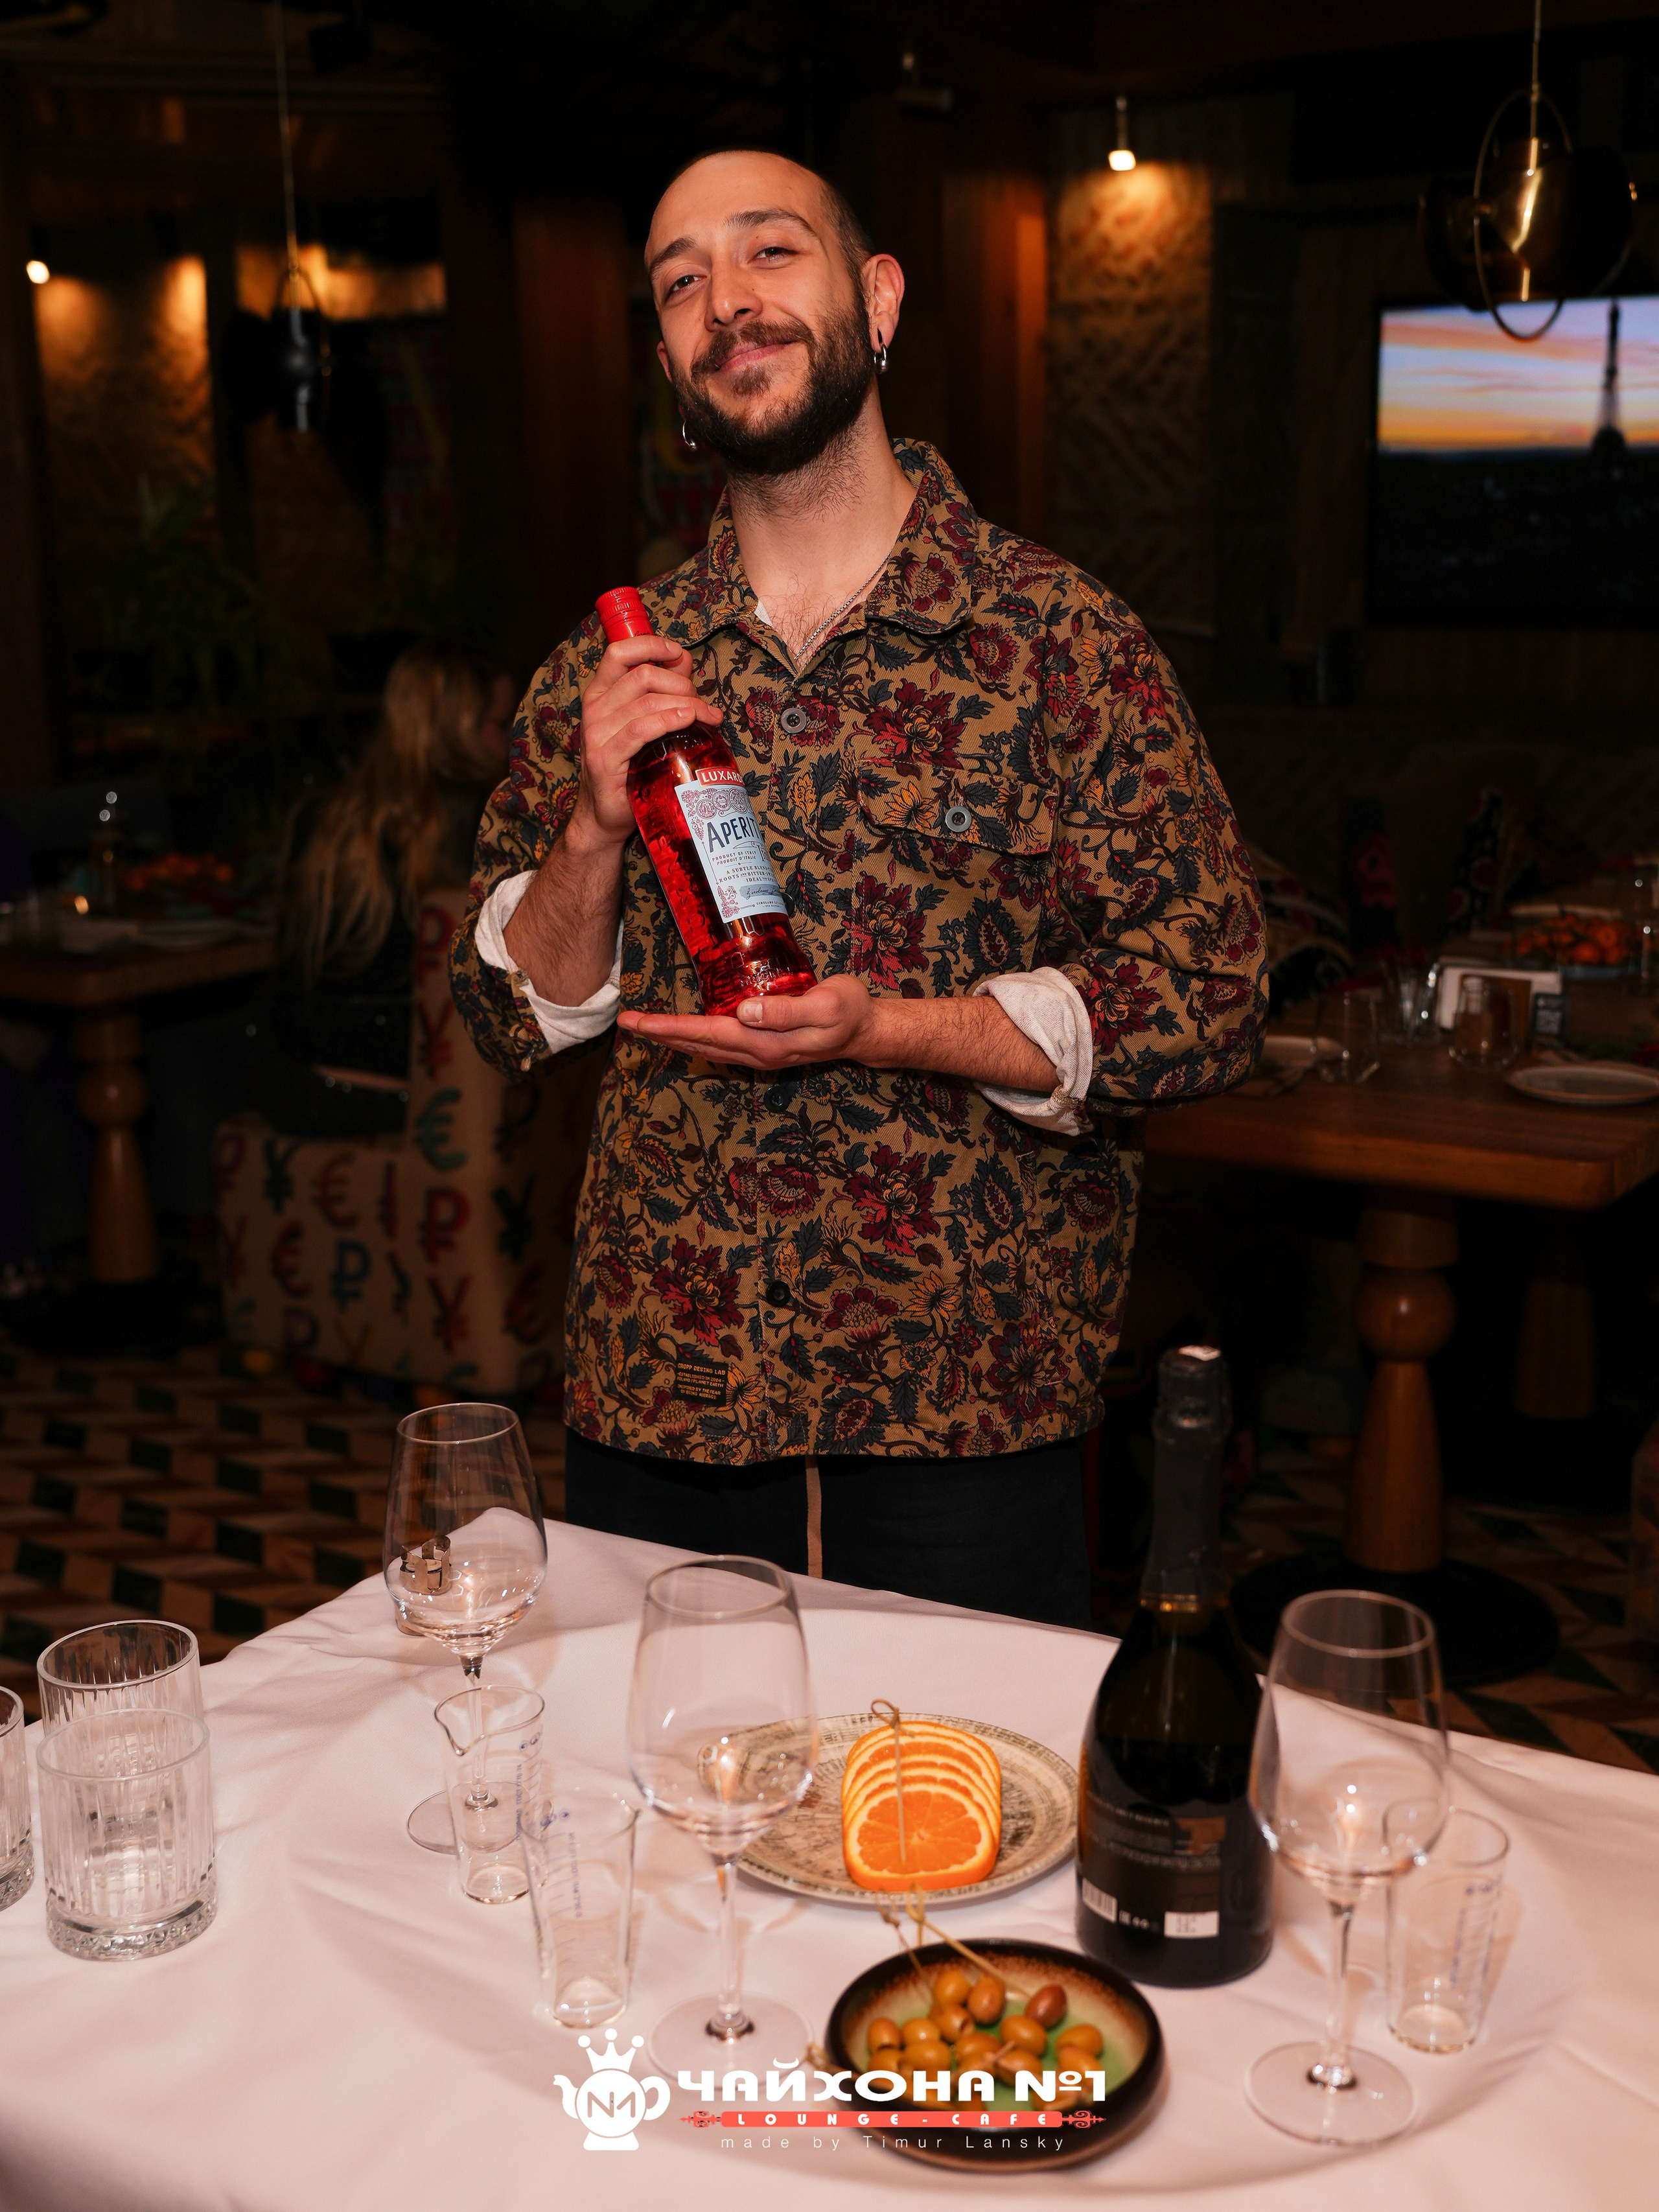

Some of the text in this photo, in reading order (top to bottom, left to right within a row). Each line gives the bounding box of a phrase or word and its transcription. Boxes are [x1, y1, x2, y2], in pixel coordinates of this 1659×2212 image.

[701, 770, 745, 784] LUXARD
[707, 817, 760, 853] APERIT
[712, 852, 736, 862] PRODUCT
[717, 857, 737, 866] PRODUIT
[732, 865, 754, 874] SUBTLE
[719, 874, 739, 883] ROOTS
